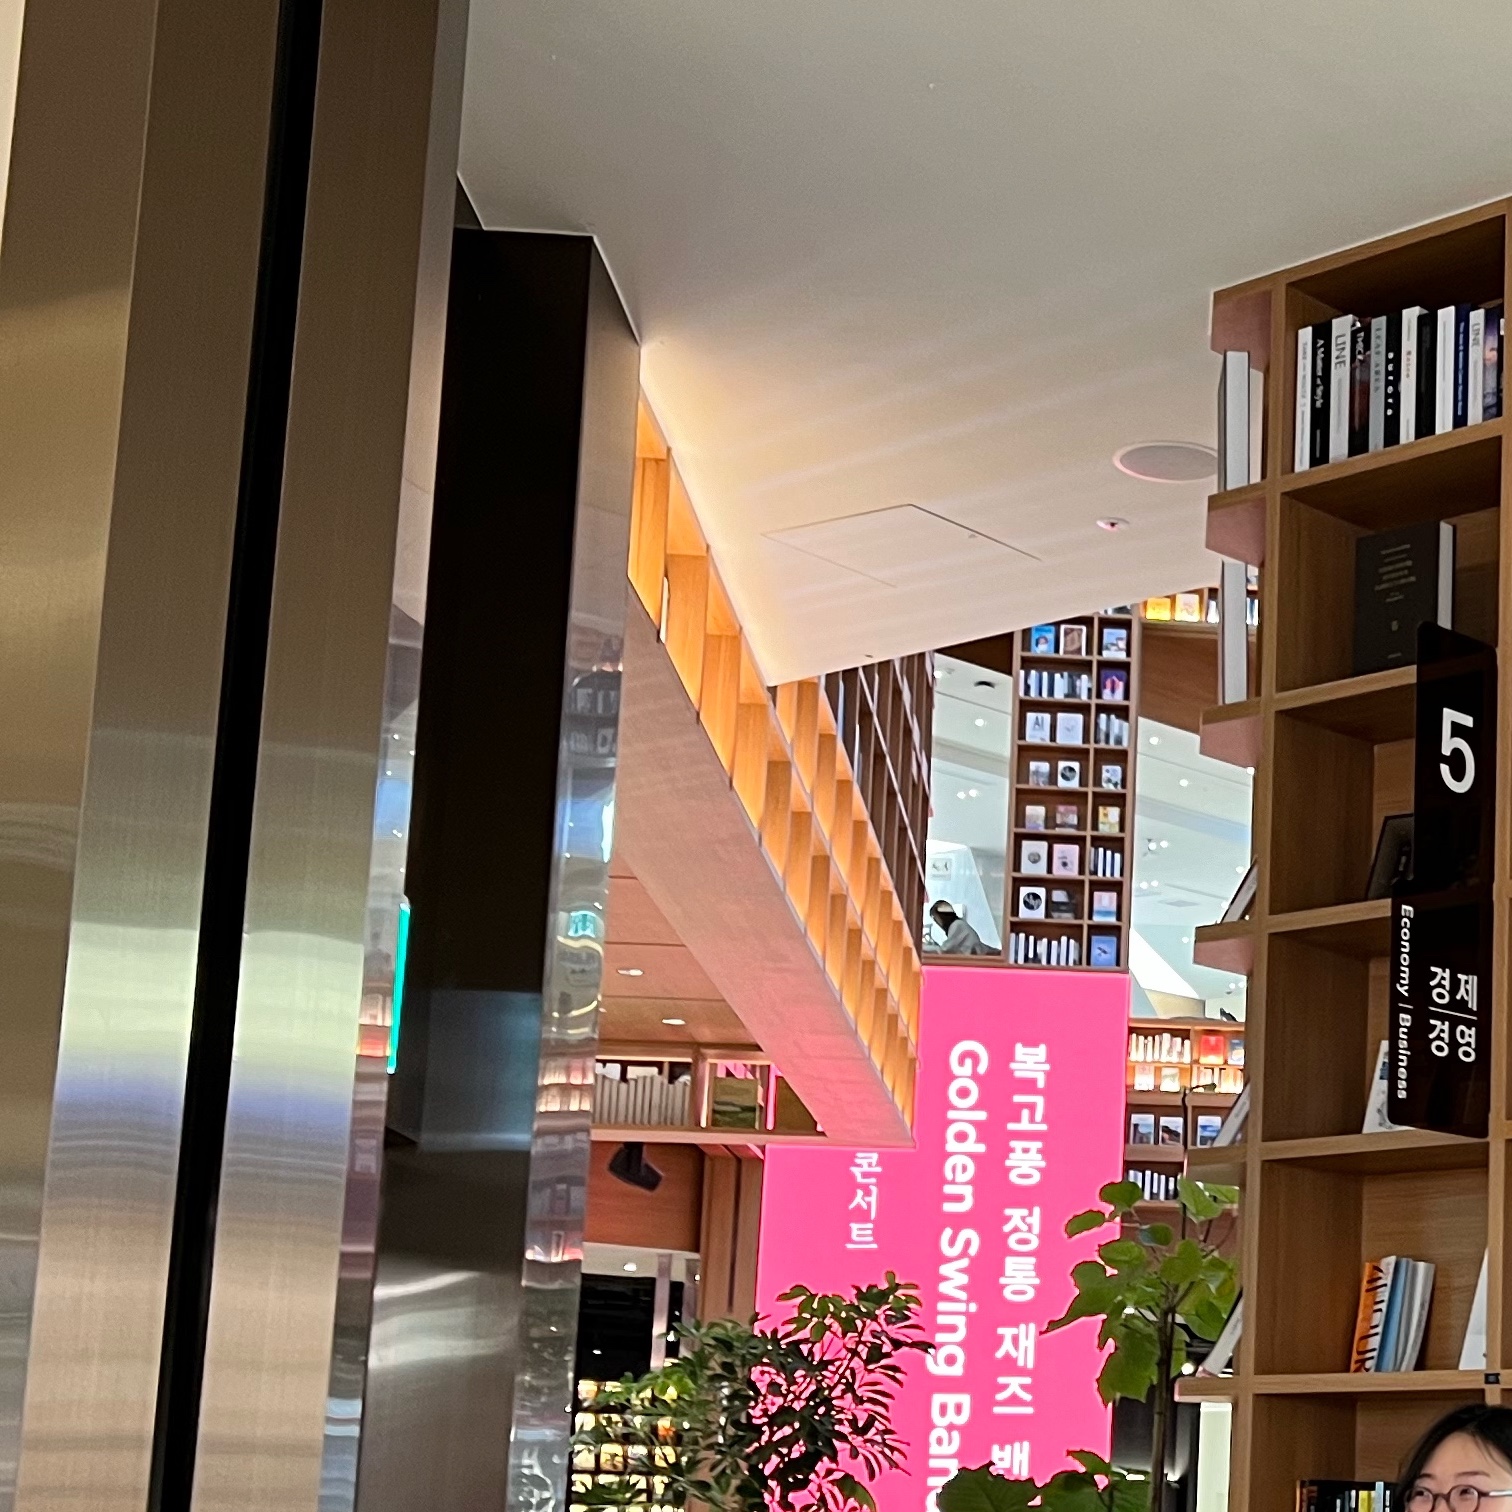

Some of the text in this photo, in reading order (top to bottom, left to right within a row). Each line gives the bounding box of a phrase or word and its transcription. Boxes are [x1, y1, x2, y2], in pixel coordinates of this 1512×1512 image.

[1334, 333, 1347, 370] LINE
[1439, 707, 1475, 793] 5
[1396, 904, 1415, 1100] Economy Business
[1429, 966, 1478, 1012] 경제
[1428, 1018, 1477, 1063] 경영
[943, 1040, 989, 1213] Golden
[1004, 1042, 1051, 1186] 복고풍
[846, 1152, 882, 1250] 콘서트
[926, 1227, 980, 1376] Swing
[998, 1206, 1042, 1302] 정통
[993, 1323, 1037, 1415] 재즈
